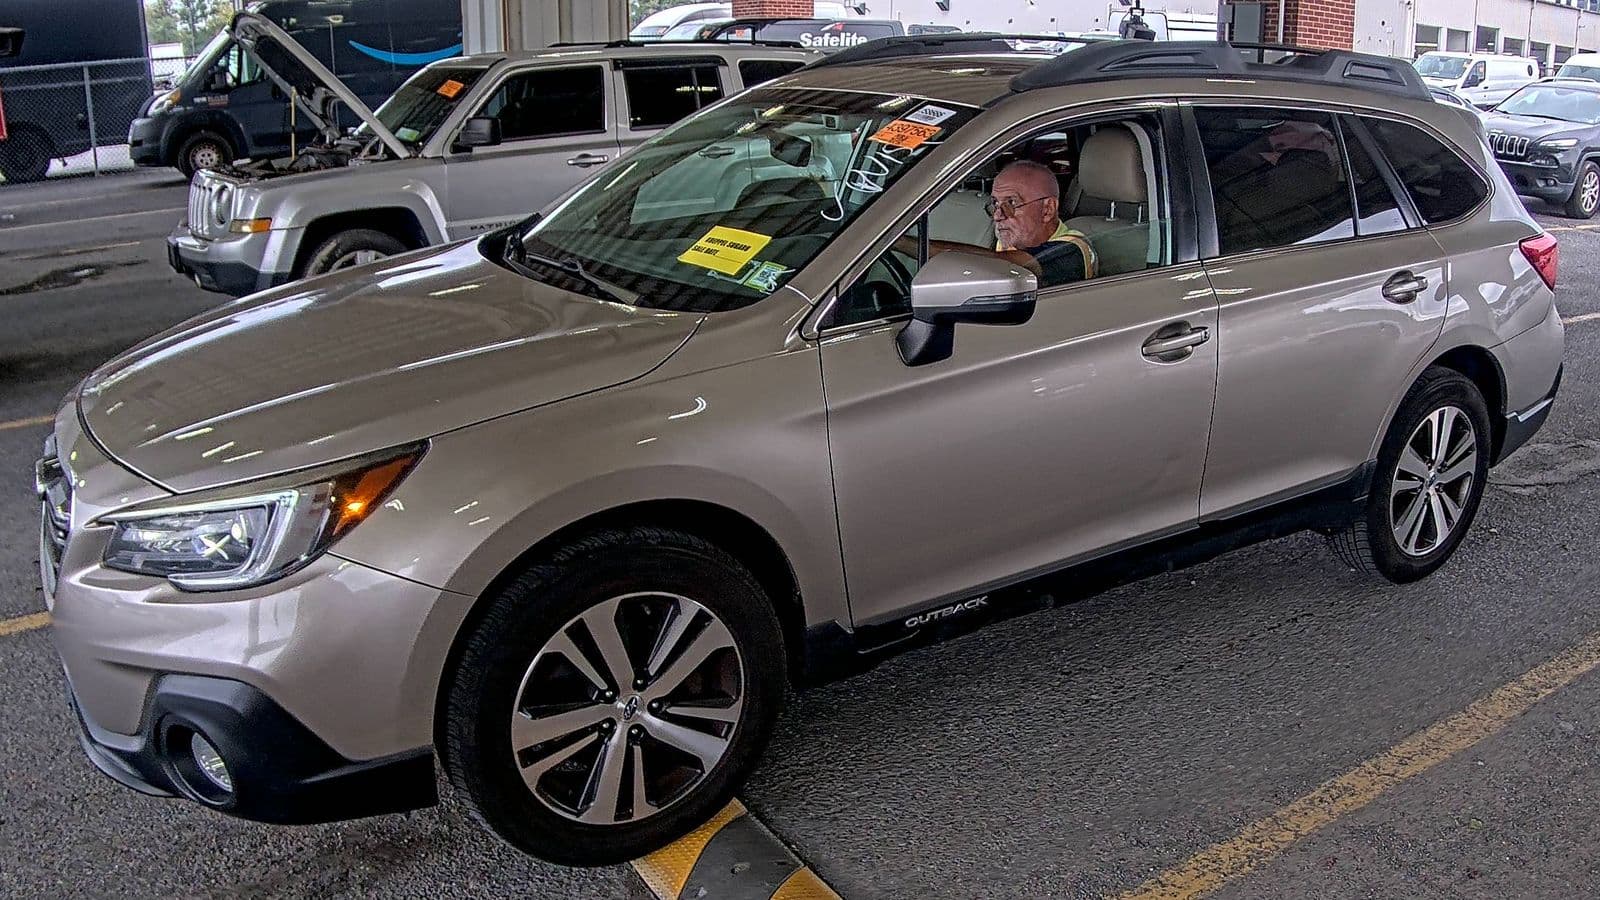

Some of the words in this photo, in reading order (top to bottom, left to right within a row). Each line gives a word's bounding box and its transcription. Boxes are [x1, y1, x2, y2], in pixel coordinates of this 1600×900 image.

[799, 32, 868, 47] Safelite
[470, 219, 517, 230] PATRIO
[727, 241, 752, 251] SUBARU
[905, 595, 988, 628] OUTBACK
